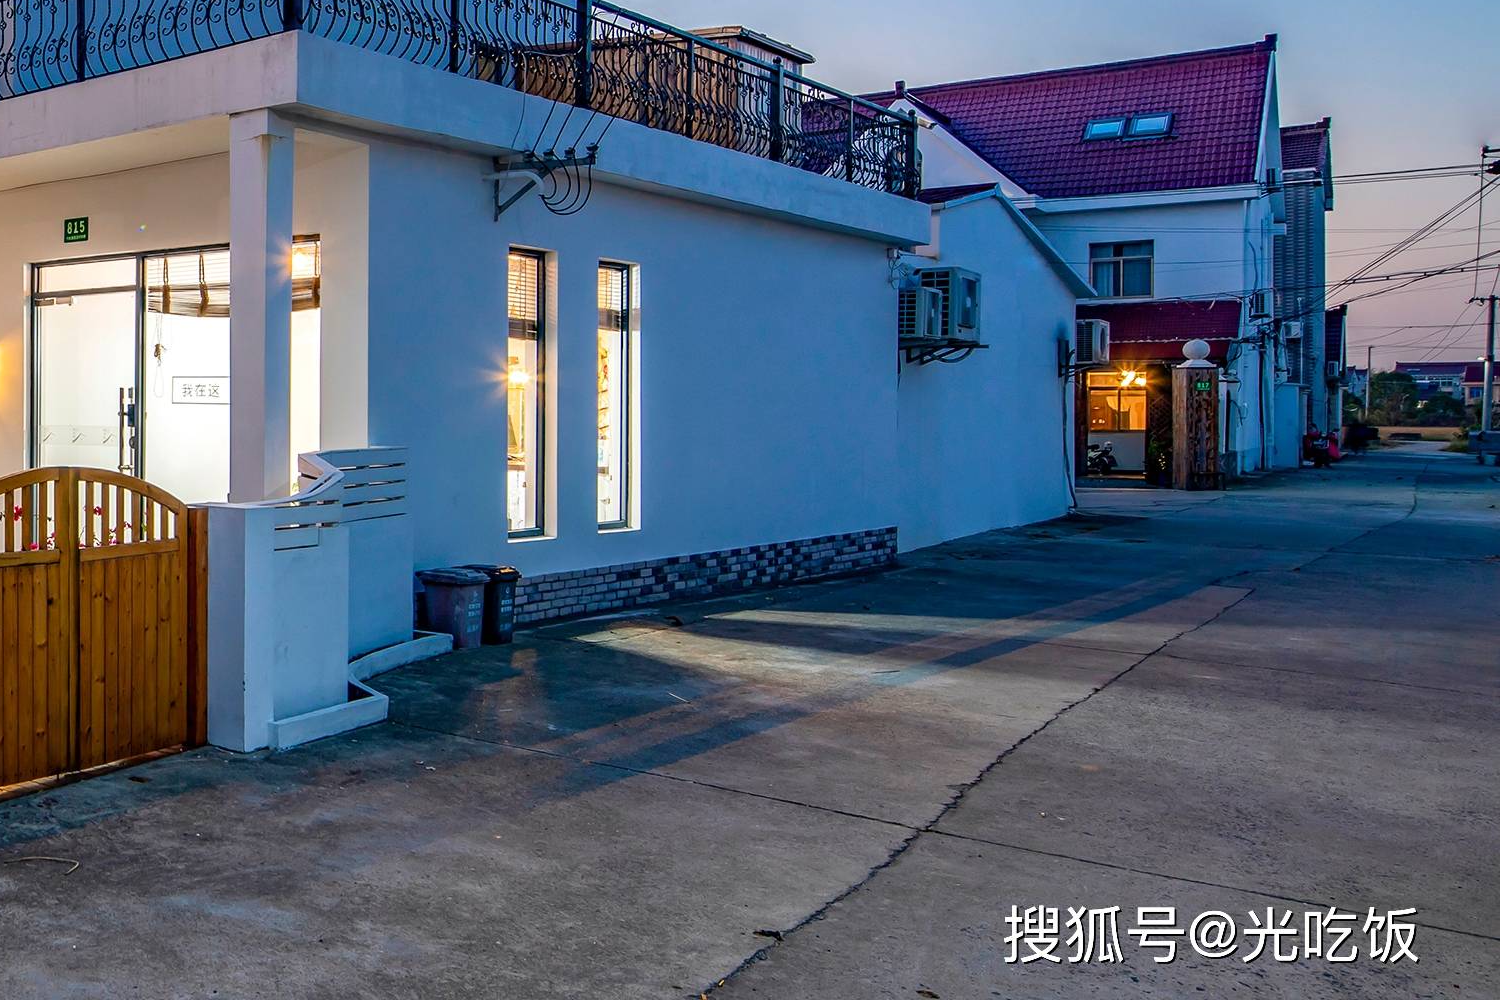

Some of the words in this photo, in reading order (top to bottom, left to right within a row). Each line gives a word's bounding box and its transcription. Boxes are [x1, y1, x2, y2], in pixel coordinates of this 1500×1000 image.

[67, 220, 85, 234] 815
[181, 383, 220, 398] 我在这
